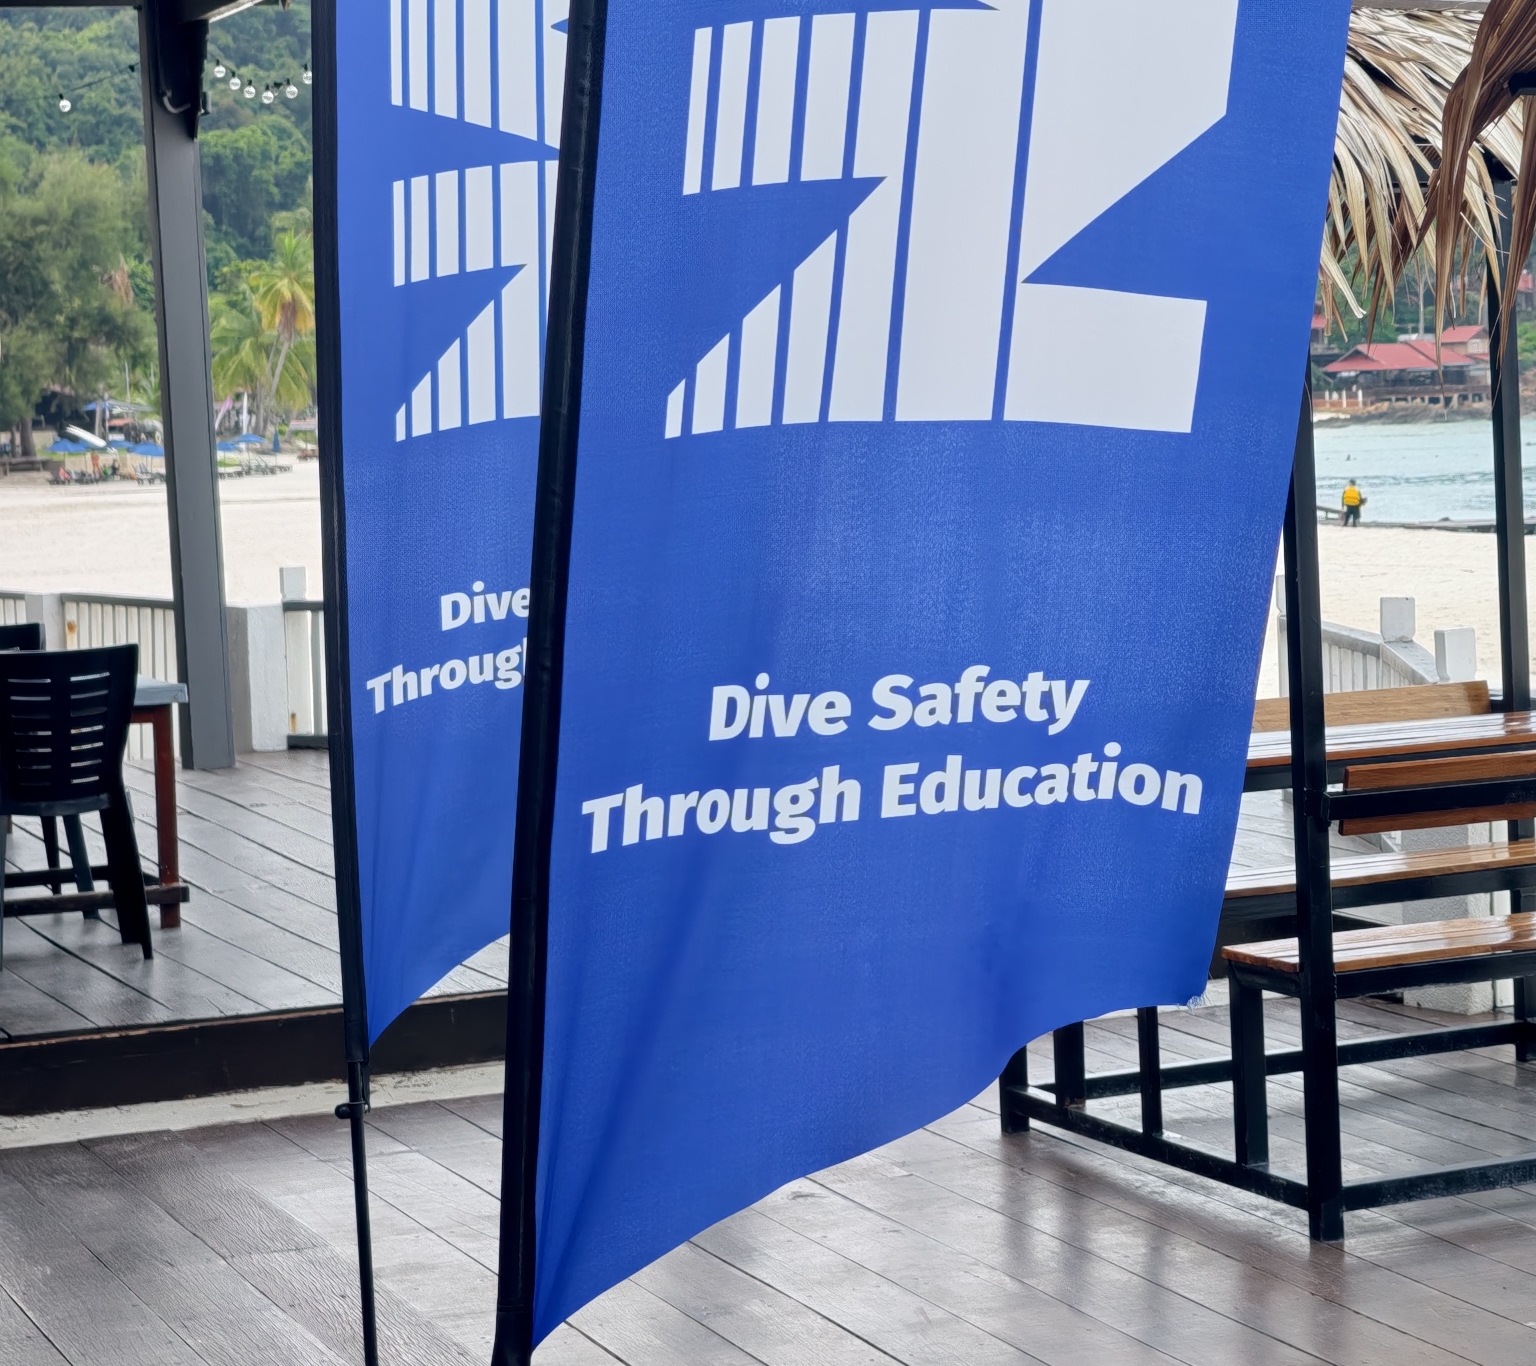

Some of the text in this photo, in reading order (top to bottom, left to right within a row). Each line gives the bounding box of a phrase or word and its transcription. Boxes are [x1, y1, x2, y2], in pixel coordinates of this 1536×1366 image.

[439, 581, 531, 631] Dive
[366, 637, 528, 714] Throug
[709, 664, 1091, 741] Dive Safety
[581, 741, 1203, 854] Through Education
